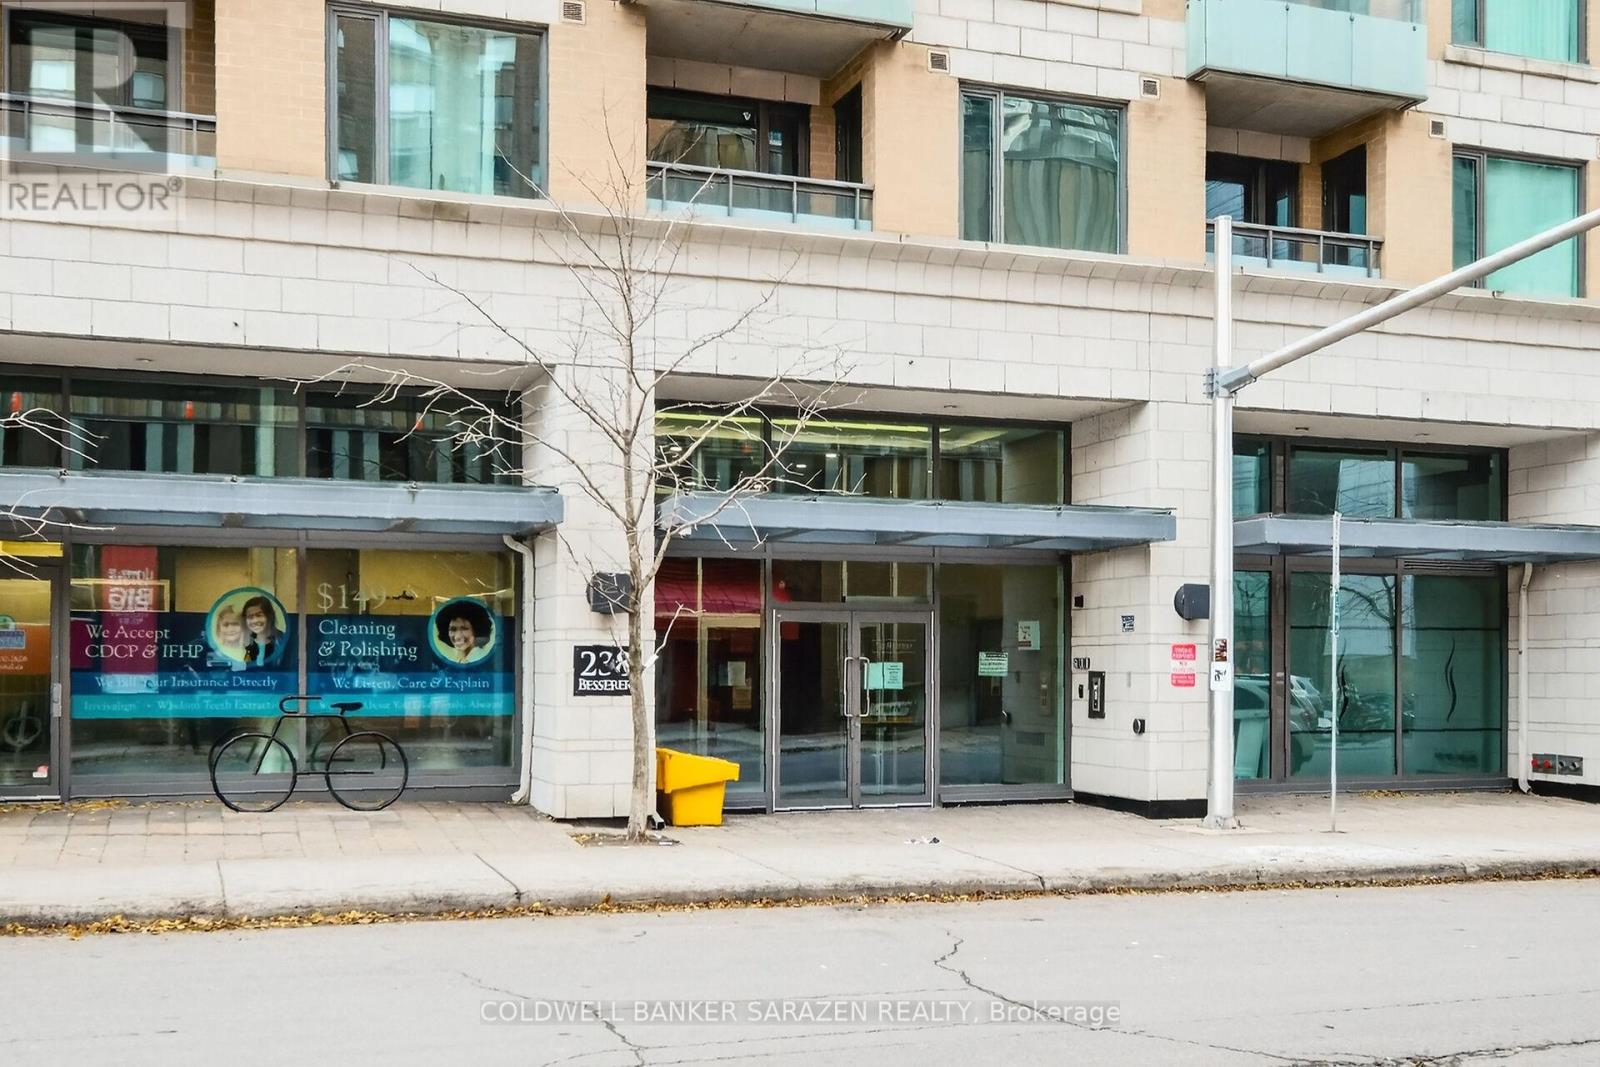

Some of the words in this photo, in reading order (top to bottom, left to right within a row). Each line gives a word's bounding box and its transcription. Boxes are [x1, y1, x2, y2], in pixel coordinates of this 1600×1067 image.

[85, 624, 110, 639] We
[114, 624, 170, 642] Accept
[318, 619, 395, 639] Cleaning
[85, 644, 138, 658] CDCP
[142, 644, 159, 658] &
[163, 644, 203, 658] IFHP
[318, 641, 336, 657] &
[341, 640, 417, 661] Polishing
[580, 651, 630, 677] 238
[172, 676, 229, 688] Insurance
[232, 676, 278, 690] Directly
[332, 677, 350, 689] We
[398, 677, 426, 689] Care
[430, 677, 443, 689] &
[445, 677, 490, 692] Explain
